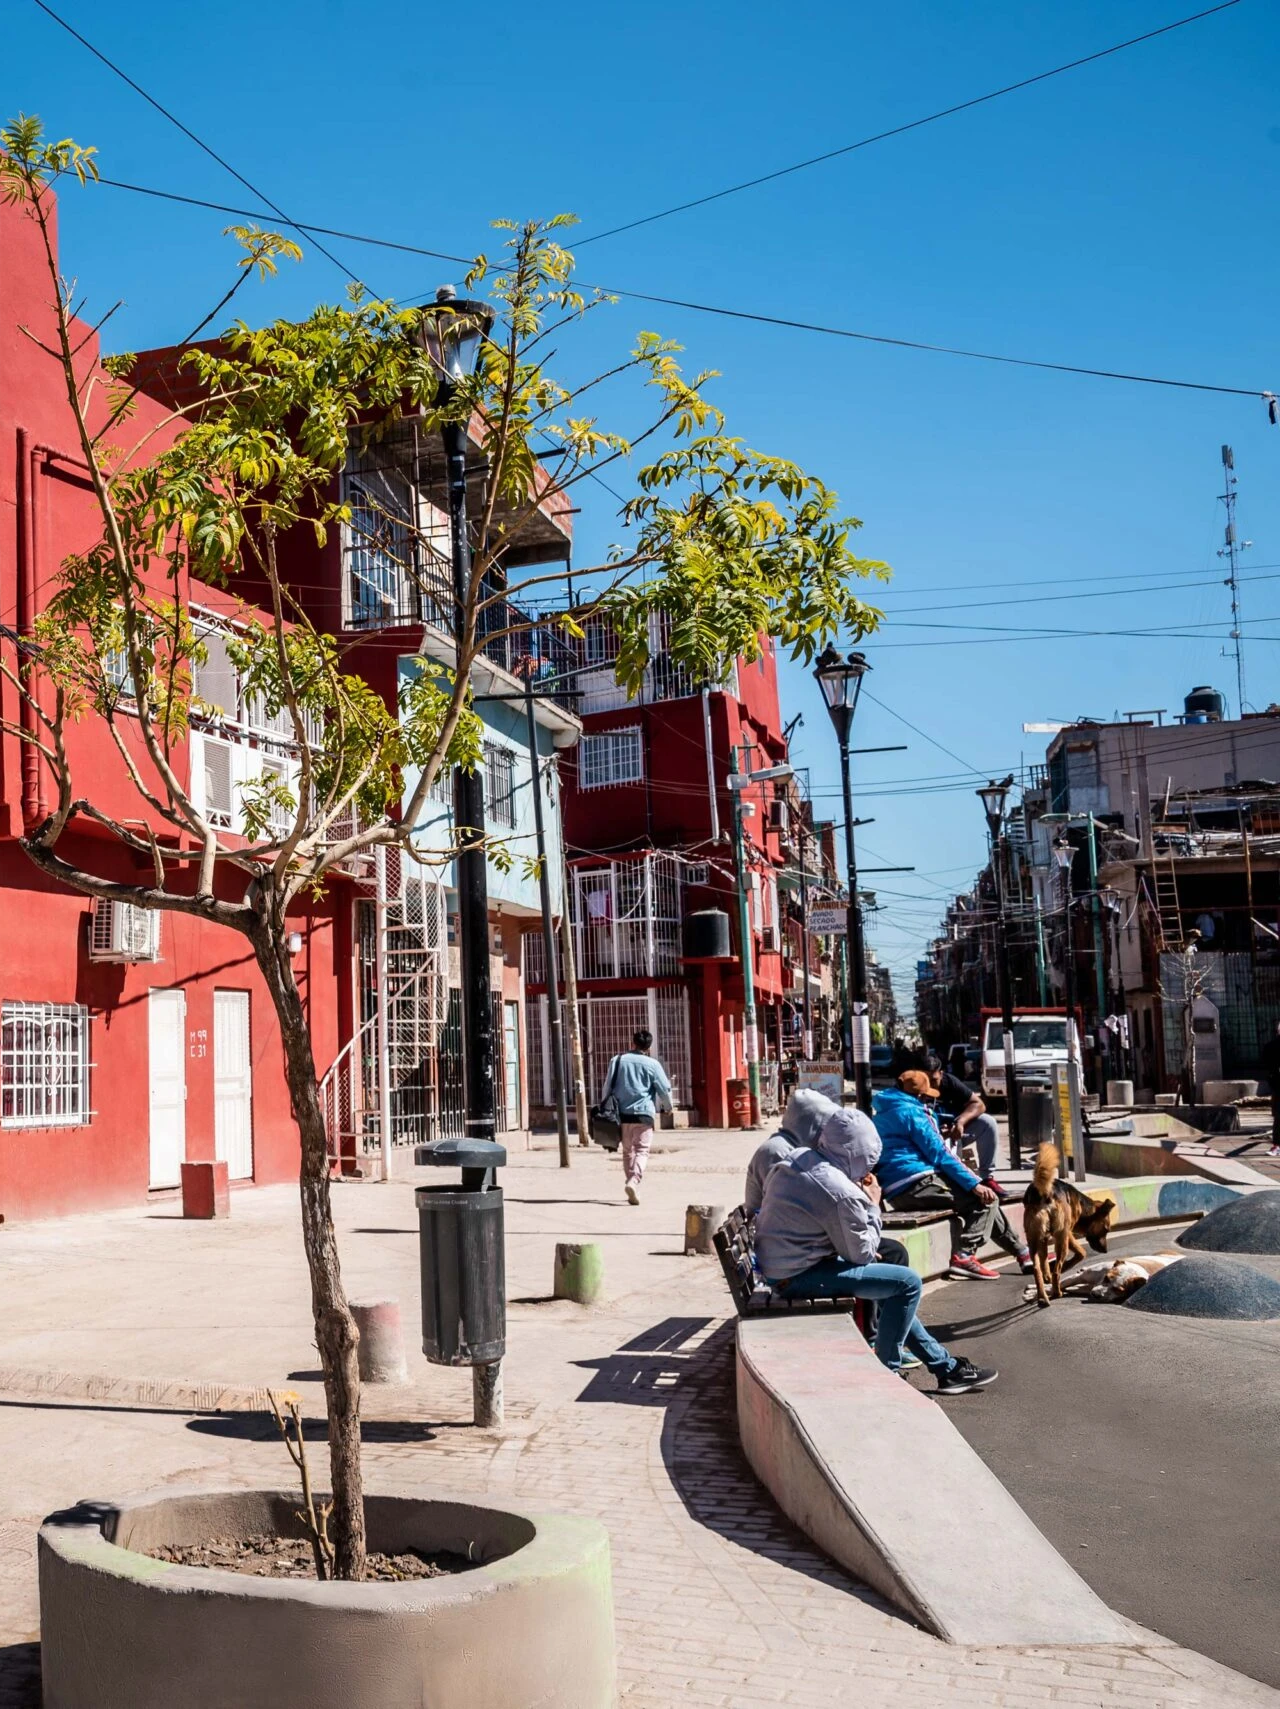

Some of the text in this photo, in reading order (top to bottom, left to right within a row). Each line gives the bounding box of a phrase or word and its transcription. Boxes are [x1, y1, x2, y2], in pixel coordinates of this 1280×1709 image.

[809, 917, 836, 925] SECADO
[189, 1029, 208, 1043] M 99
[197, 1044, 207, 1058] 31
